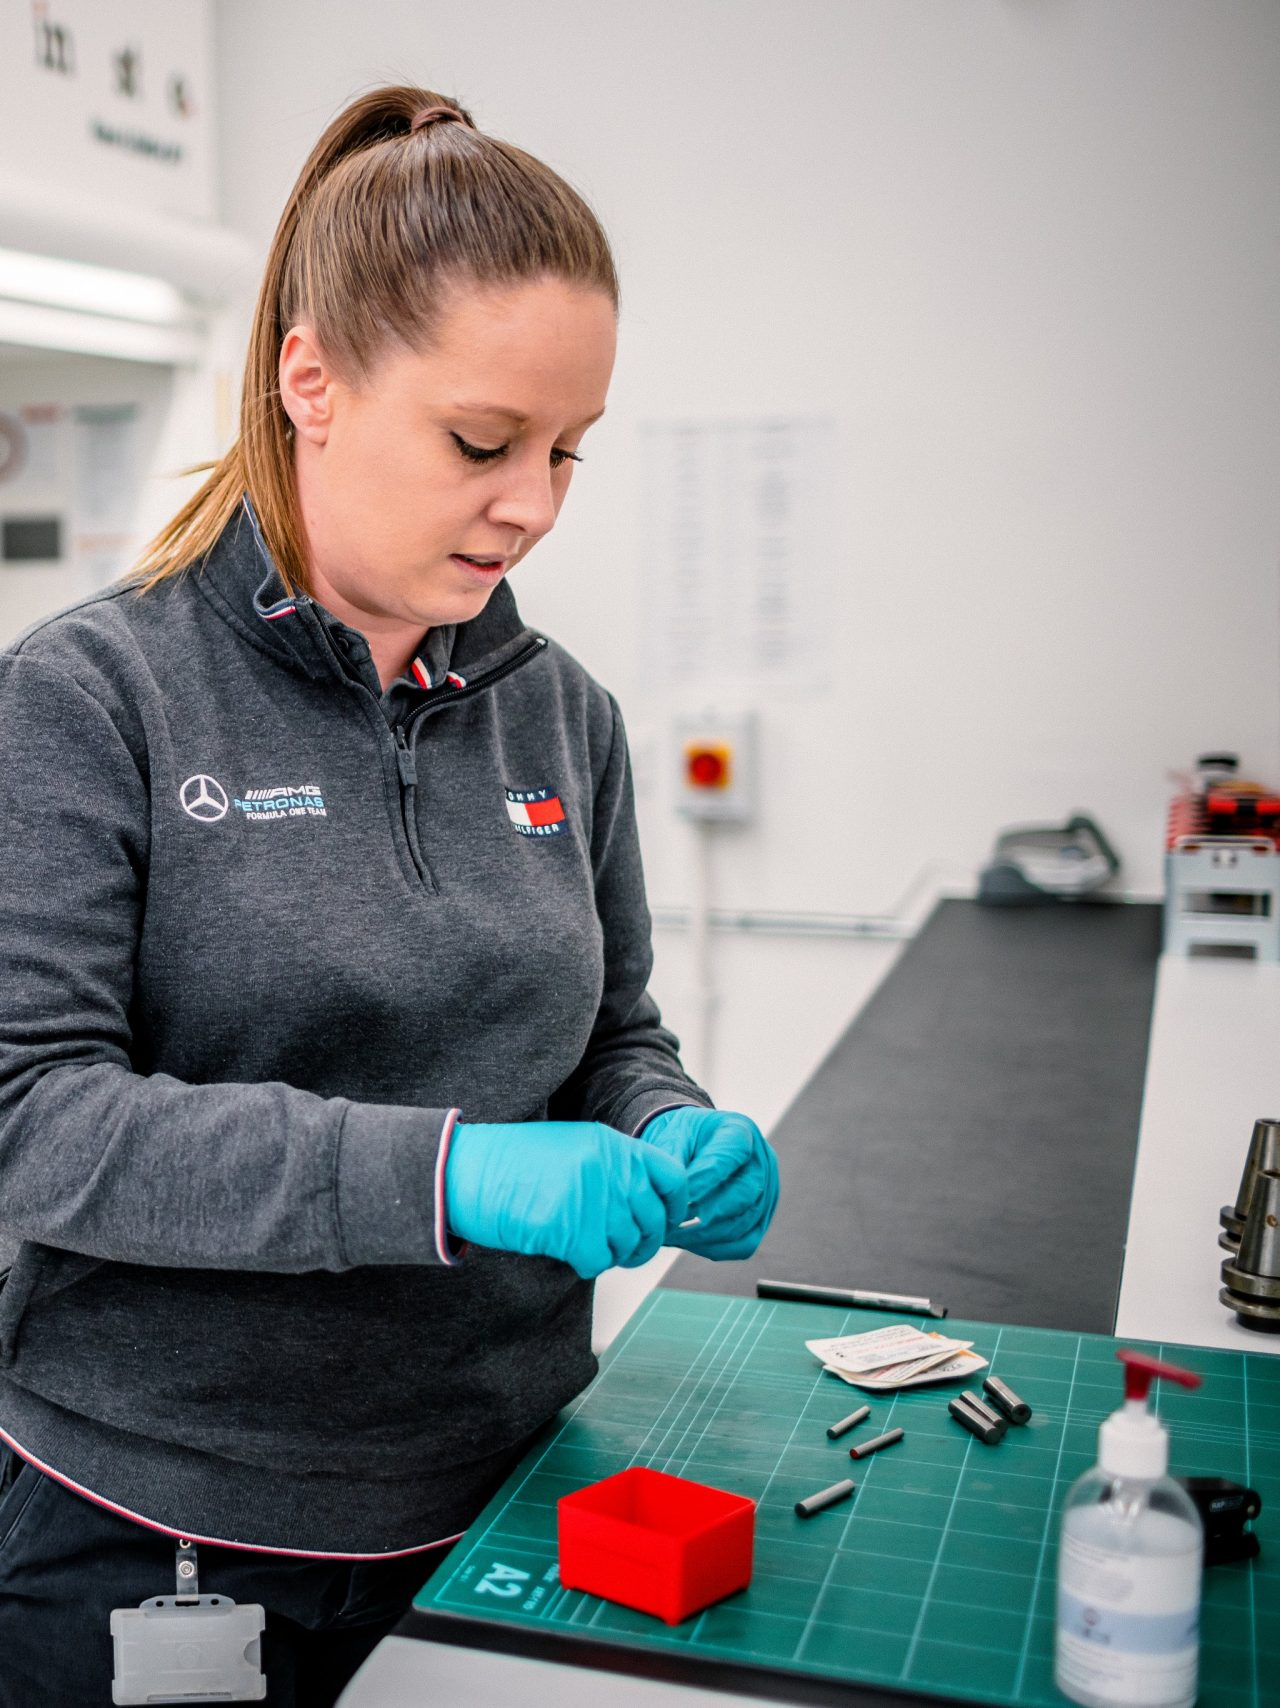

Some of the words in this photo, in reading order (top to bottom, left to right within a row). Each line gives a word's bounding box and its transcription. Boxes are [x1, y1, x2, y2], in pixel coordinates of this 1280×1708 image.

[269, 785, 322, 799] AMG
[505, 789, 546, 801] OMMY
[234, 796, 325, 812] PETRONAS
[246, 809, 288, 820] FORMULA
[289, 807, 307, 816] ONE
[306, 807, 327, 817] TEAM
[474, 1561, 532, 1598] A2
